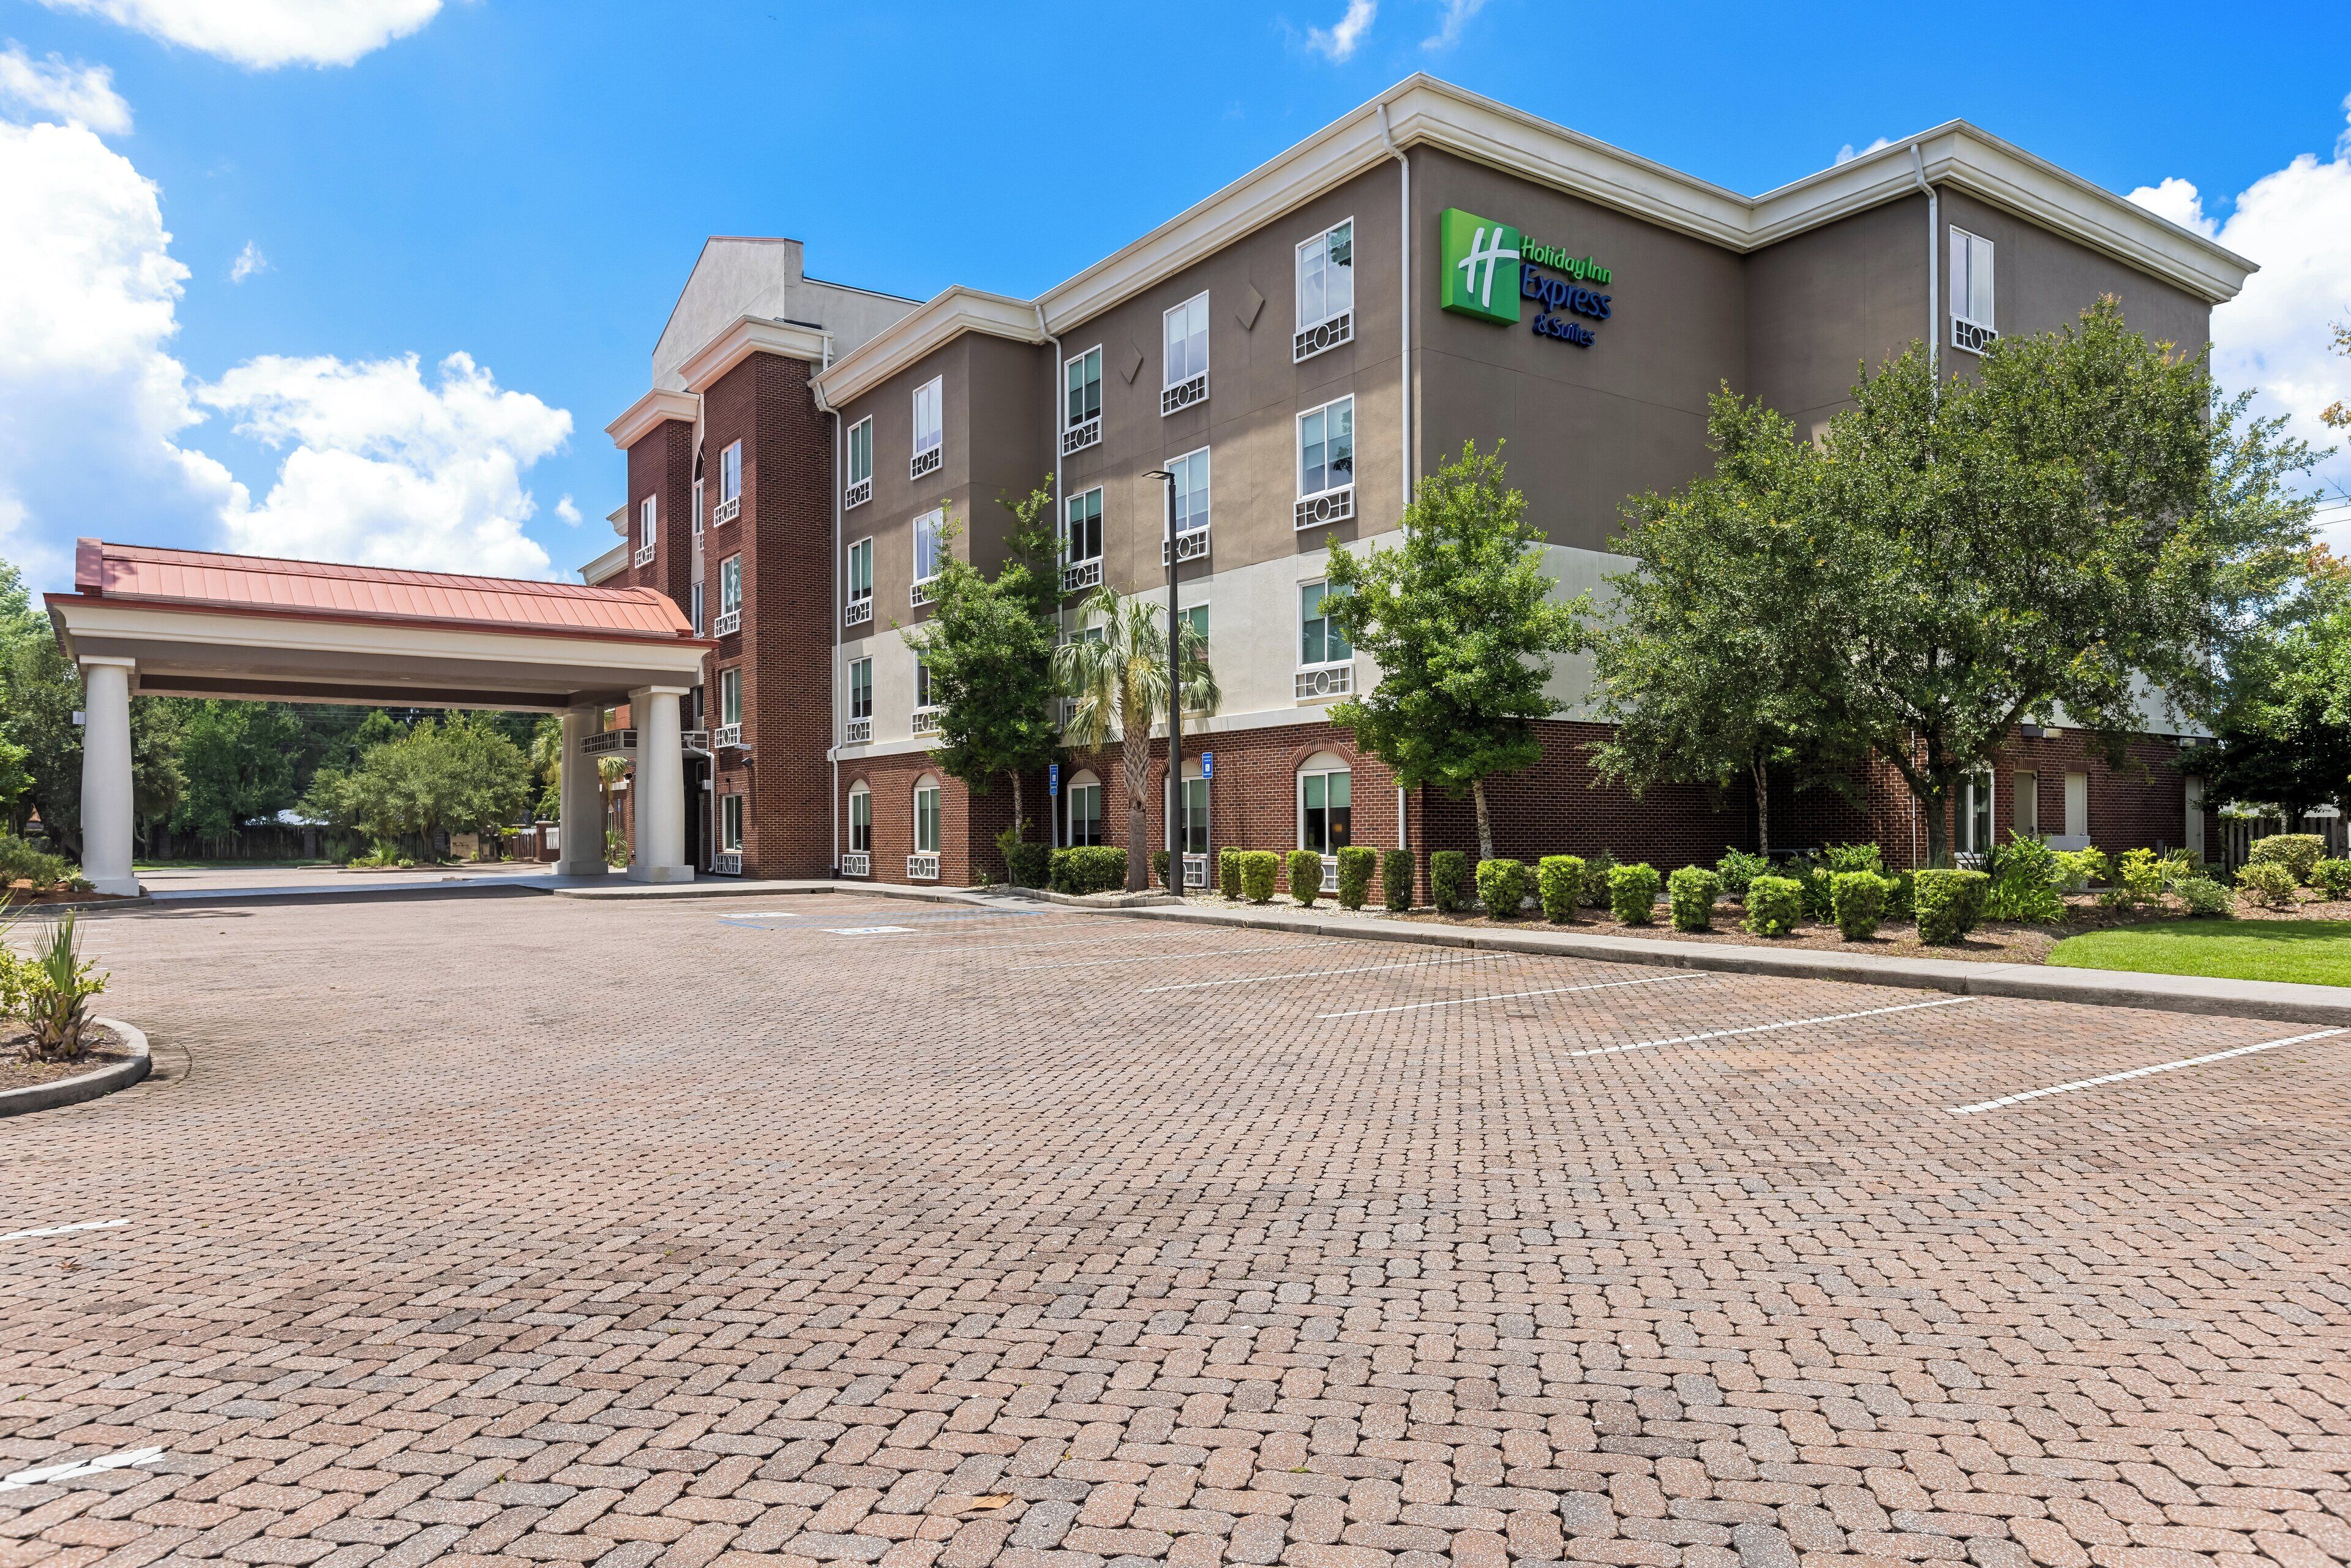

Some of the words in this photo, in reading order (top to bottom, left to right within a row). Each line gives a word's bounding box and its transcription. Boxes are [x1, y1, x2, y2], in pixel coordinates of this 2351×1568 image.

[1521, 234, 1586, 280] Holiday
[1588, 256, 1612, 284] Inn
[1522, 264, 1612, 320] Express
[1535, 313, 1548, 335] &
[1550, 317, 1595, 347] Suites
